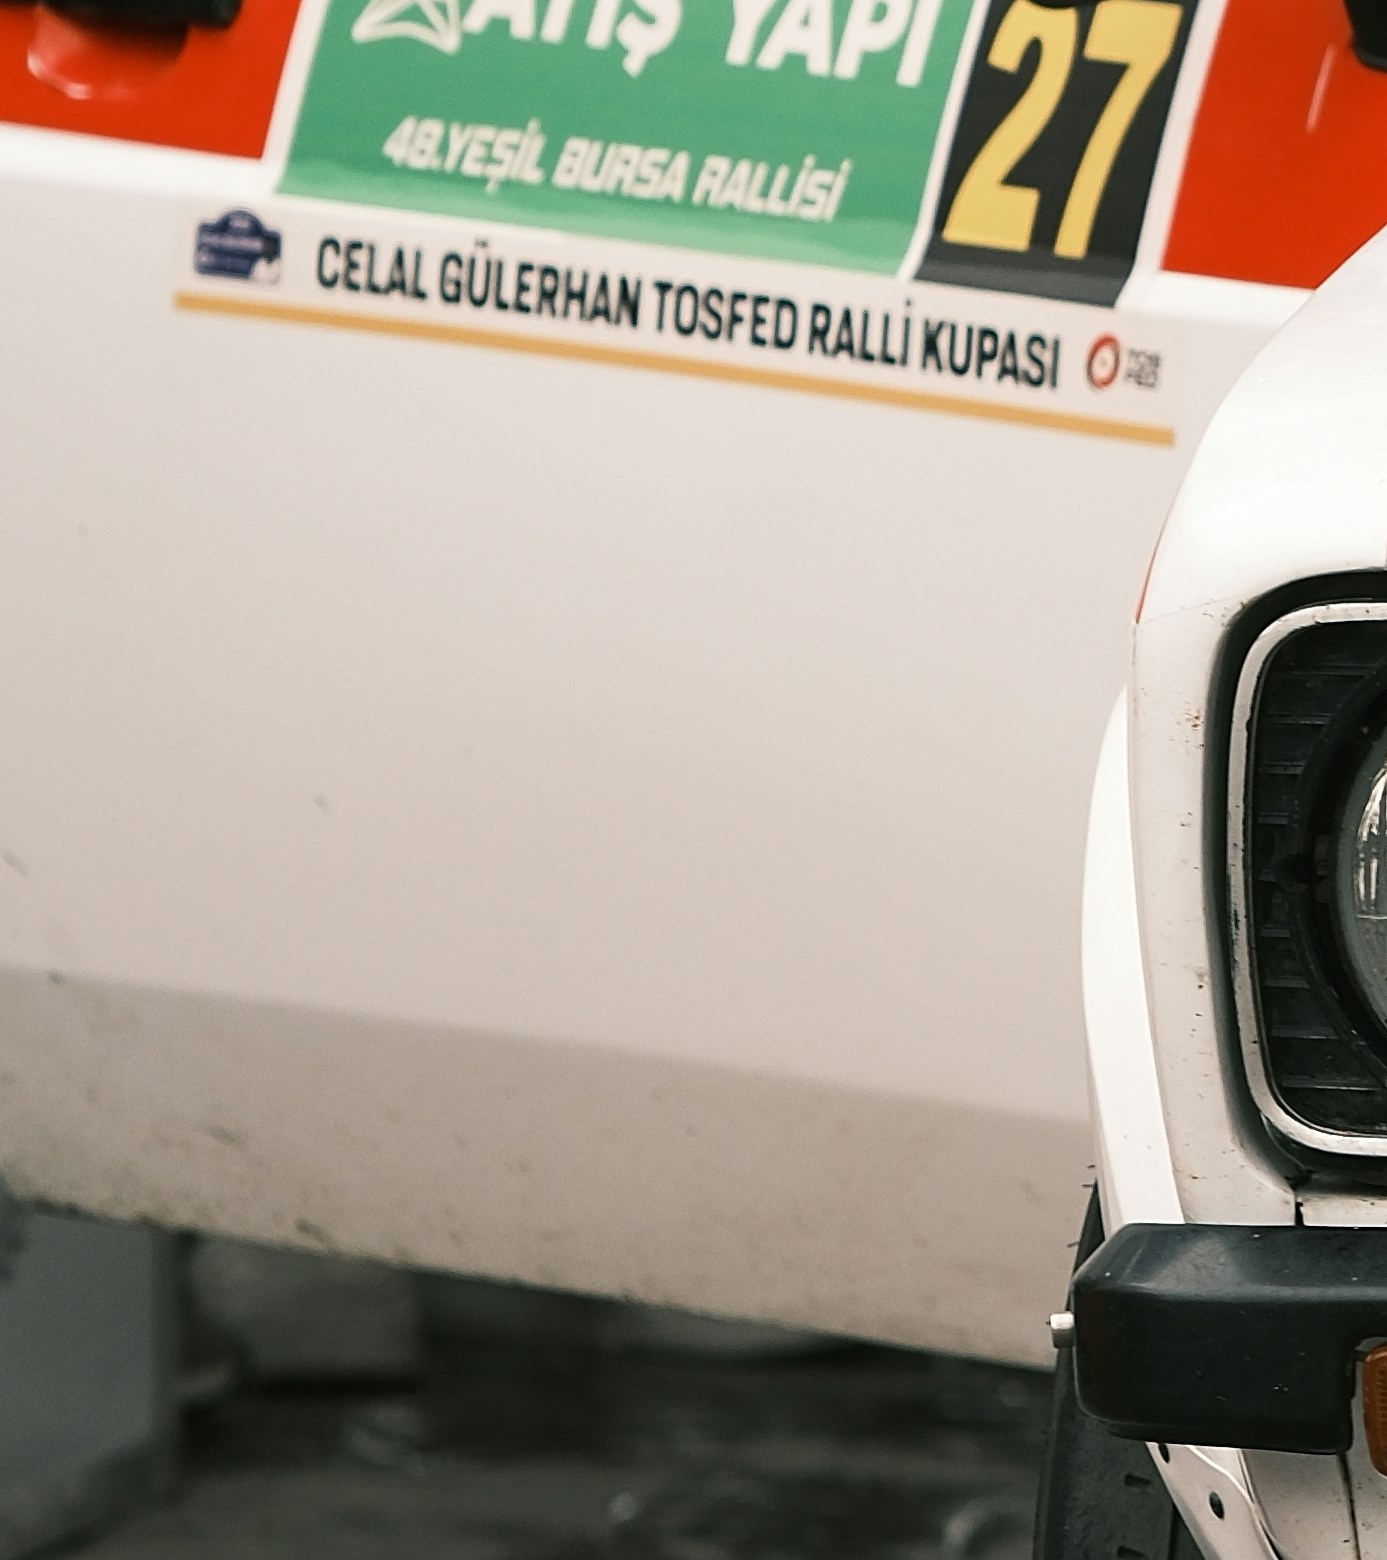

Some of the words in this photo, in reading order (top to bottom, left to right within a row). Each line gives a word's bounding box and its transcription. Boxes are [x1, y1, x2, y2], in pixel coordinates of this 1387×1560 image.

[382, 115, 546, 195] 48.YEŞİL
[552, 137, 691, 202] BURSA
[692, 154, 853, 221] RALLİSİ
[316, 236, 428, 301] CELAL
[438, 240, 641, 328] GÜLERHAN
[654, 280, 797, 349] TOSFED
[808, 299, 912, 367] RALLİ
[921, 317, 1062, 389] KUPASI
